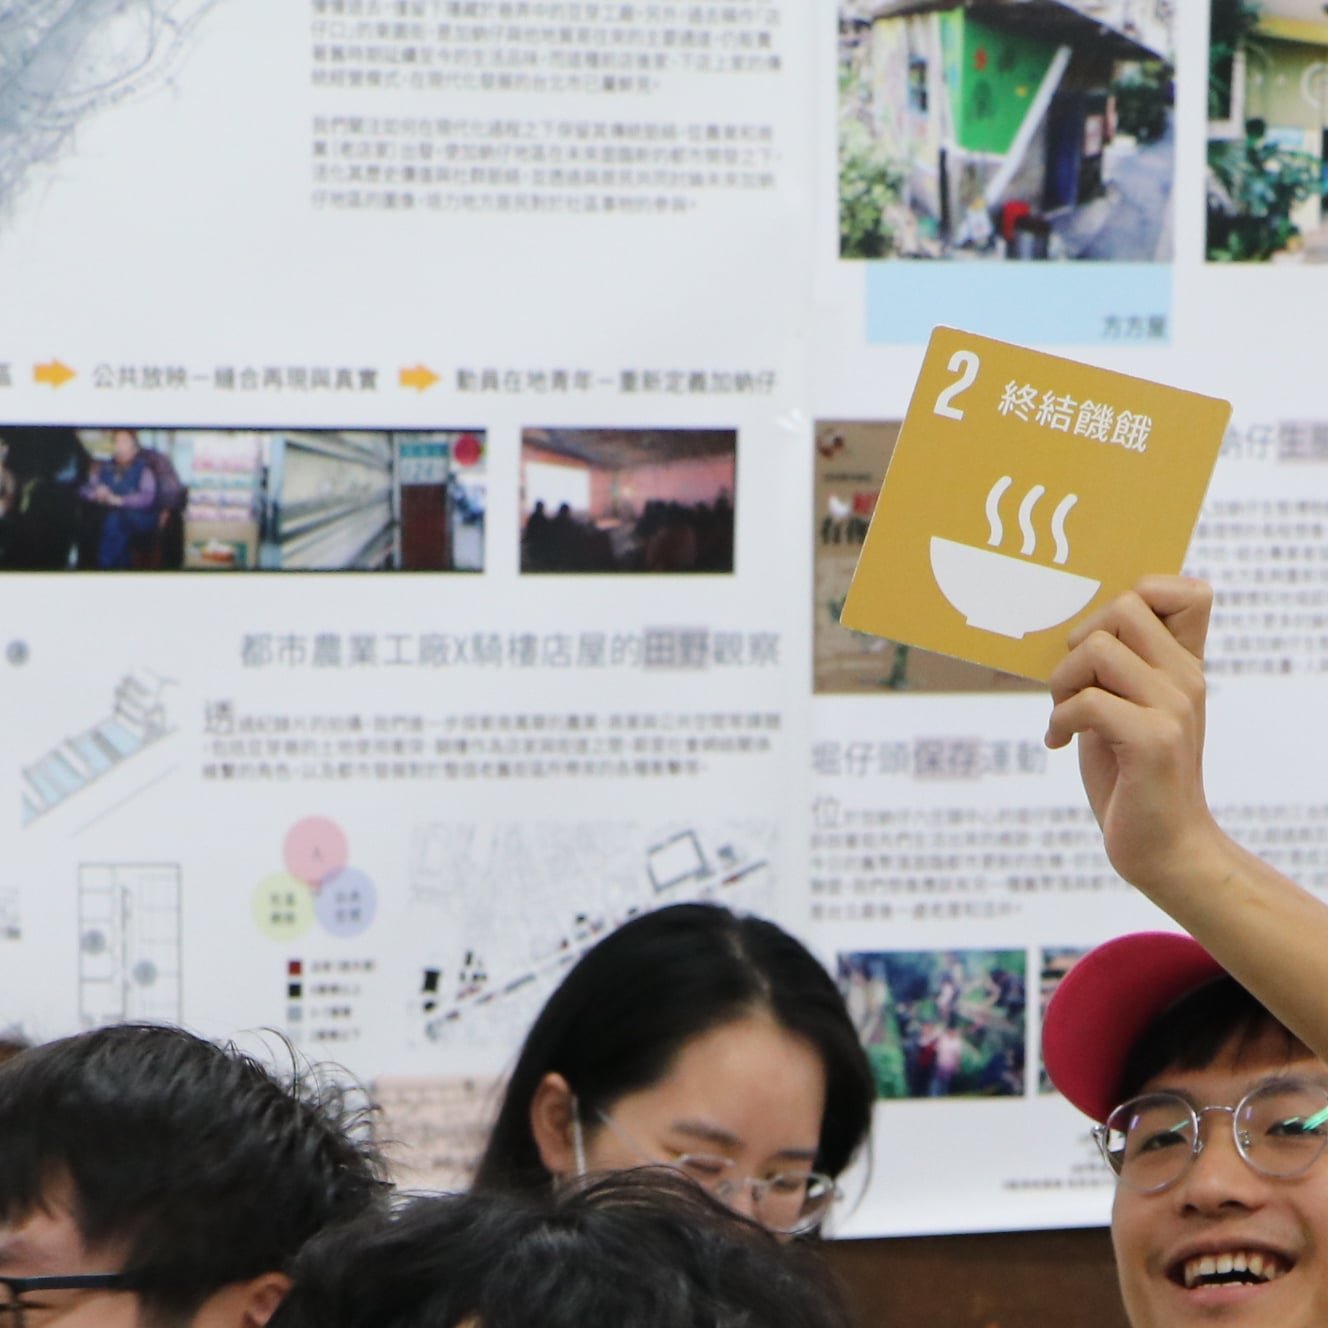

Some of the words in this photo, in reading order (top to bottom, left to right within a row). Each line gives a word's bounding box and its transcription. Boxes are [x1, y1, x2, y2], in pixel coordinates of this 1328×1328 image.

[932, 350, 980, 421] 2
[997, 379, 1152, 453] 終結饑餓
